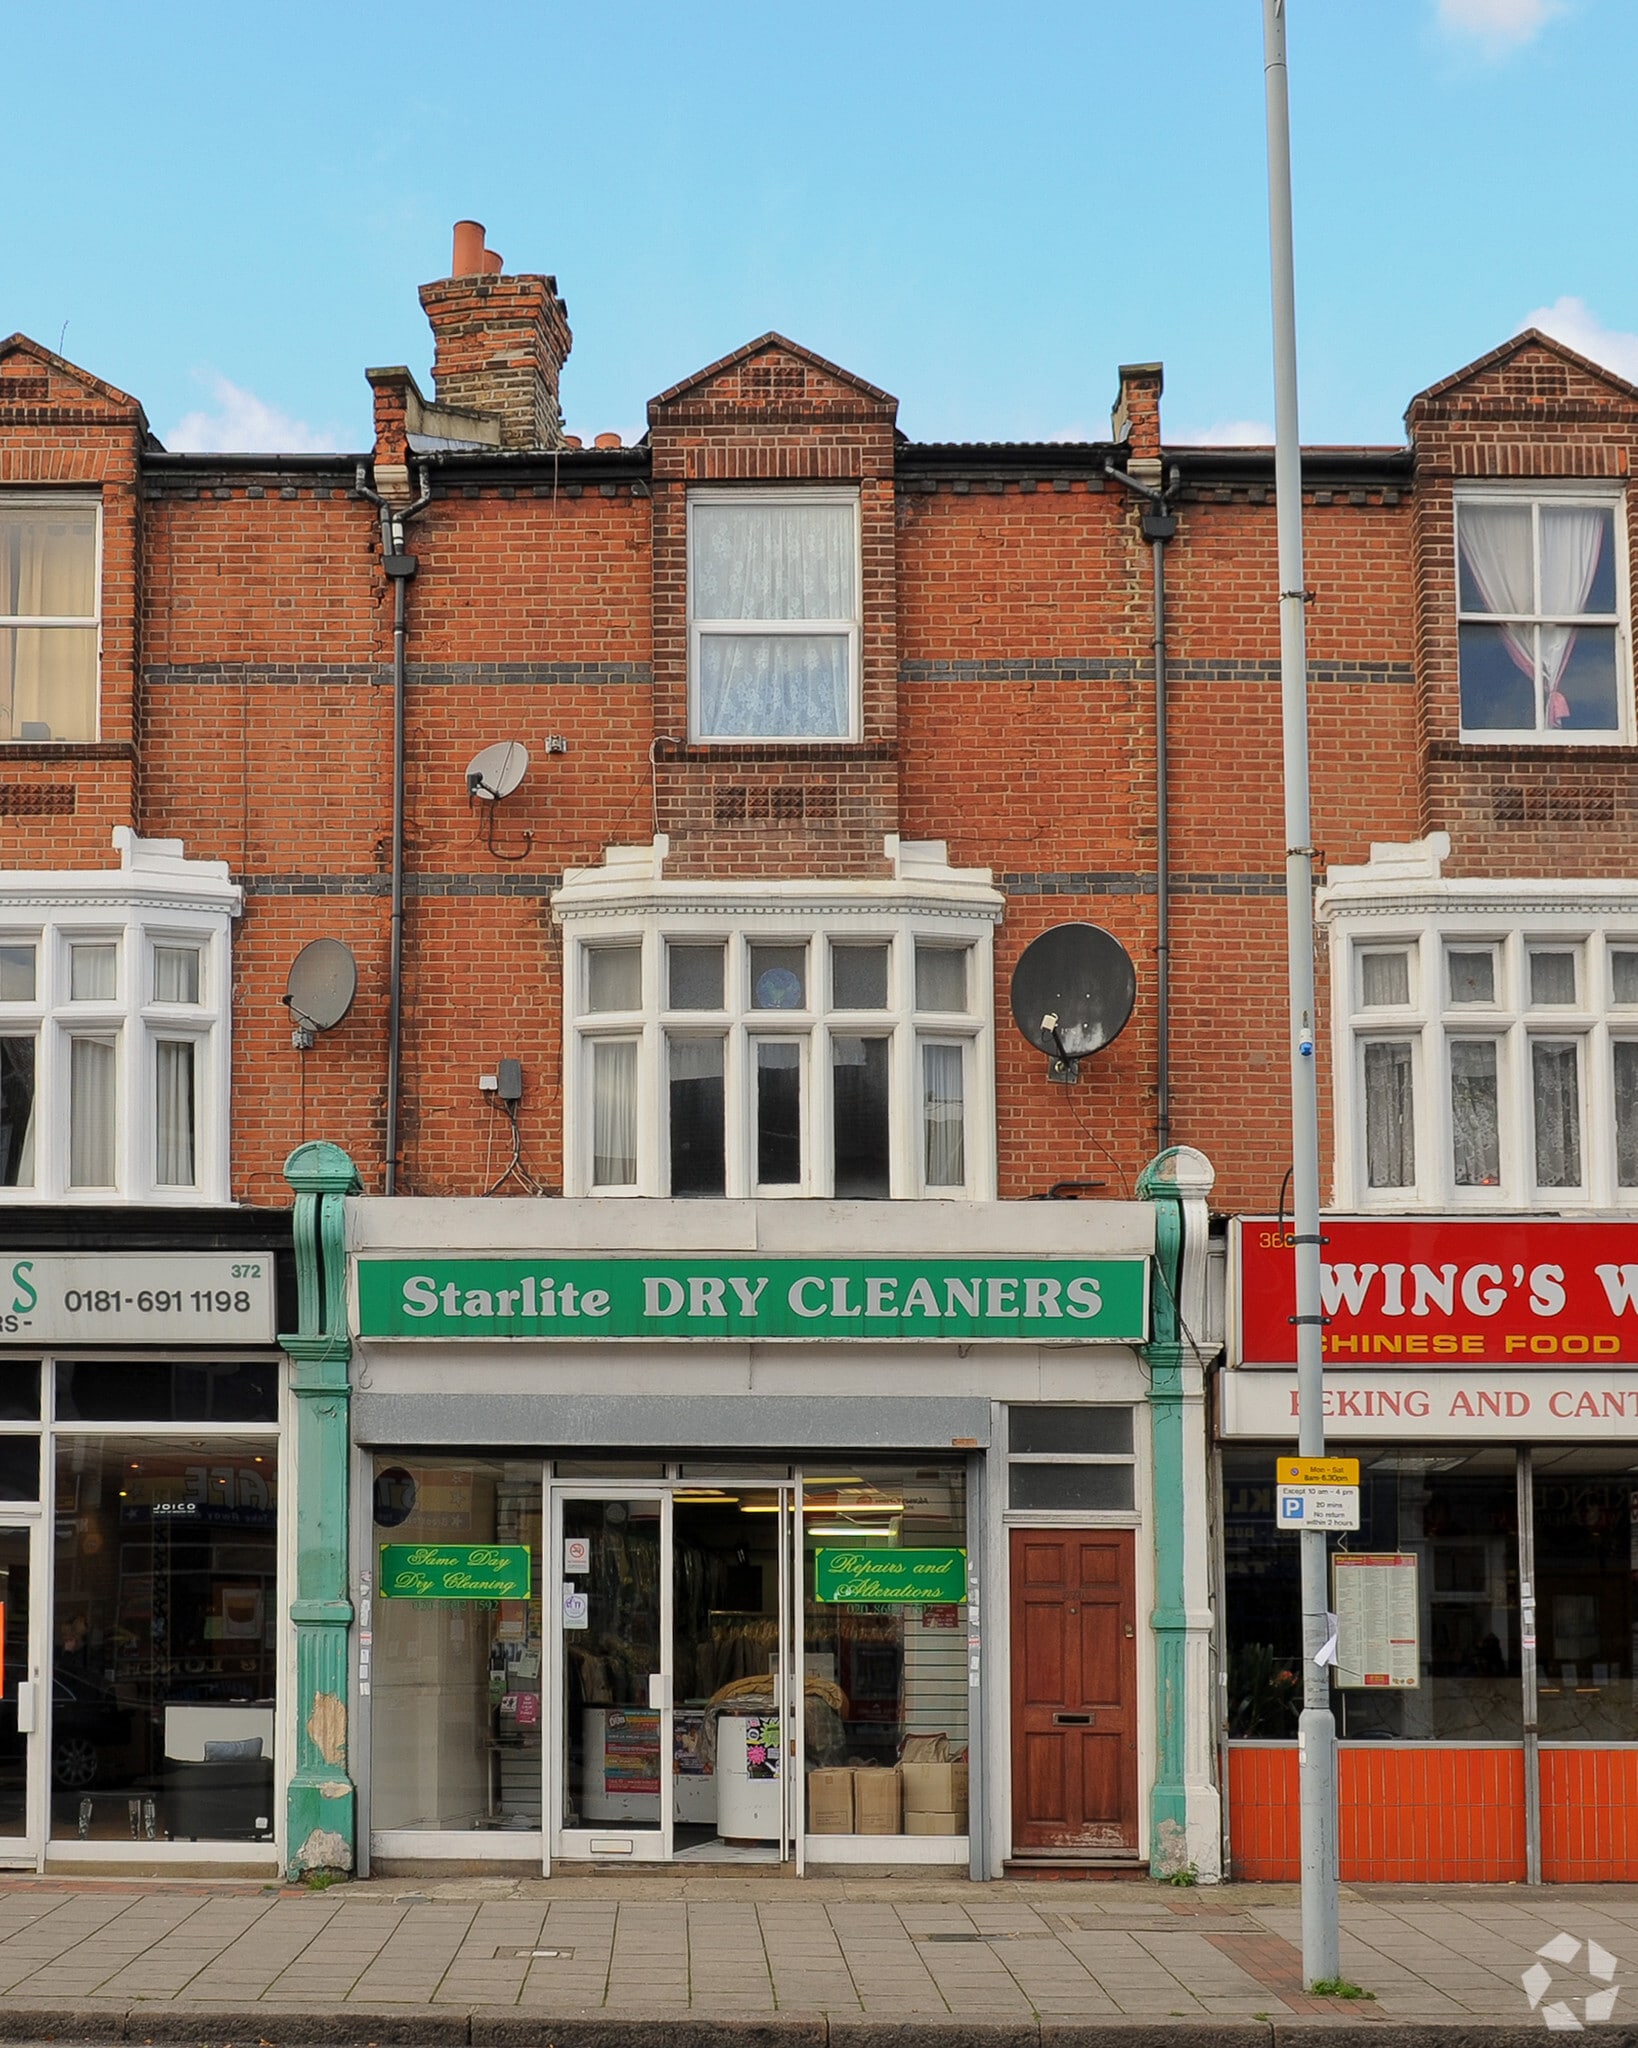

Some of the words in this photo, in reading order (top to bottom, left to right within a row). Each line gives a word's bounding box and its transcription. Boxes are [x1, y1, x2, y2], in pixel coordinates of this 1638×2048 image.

[231, 1265, 261, 1278] 372
[64, 1290, 182, 1312] 0181-691
[190, 1290, 251, 1312] 1198
[402, 1275, 612, 1317] Starlite
[642, 1277, 769, 1317] DRY
[788, 1276, 1103, 1319] CLEANERS
[1319, 1263, 1567, 1317] WING'S
[1320, 1335, 1485, 1353] HINESE
[1504, 1335, 1620, 1354] FOOD
[1448, 1391, 1531, 1417] AND
[407, 1548, 459, 1566] Same
[467, 1549, 512, 1572] Day
[828, 1553, 906, 1578] Repairs
[913, 1560, 954, 1575] and
[394, 1571, 435, 1594] Dry
[443, 1572, 517, 1595] Cleaning
[836, 1578, 945, 1598] Alterations
[474, 1600, 499, 1611] 1592
